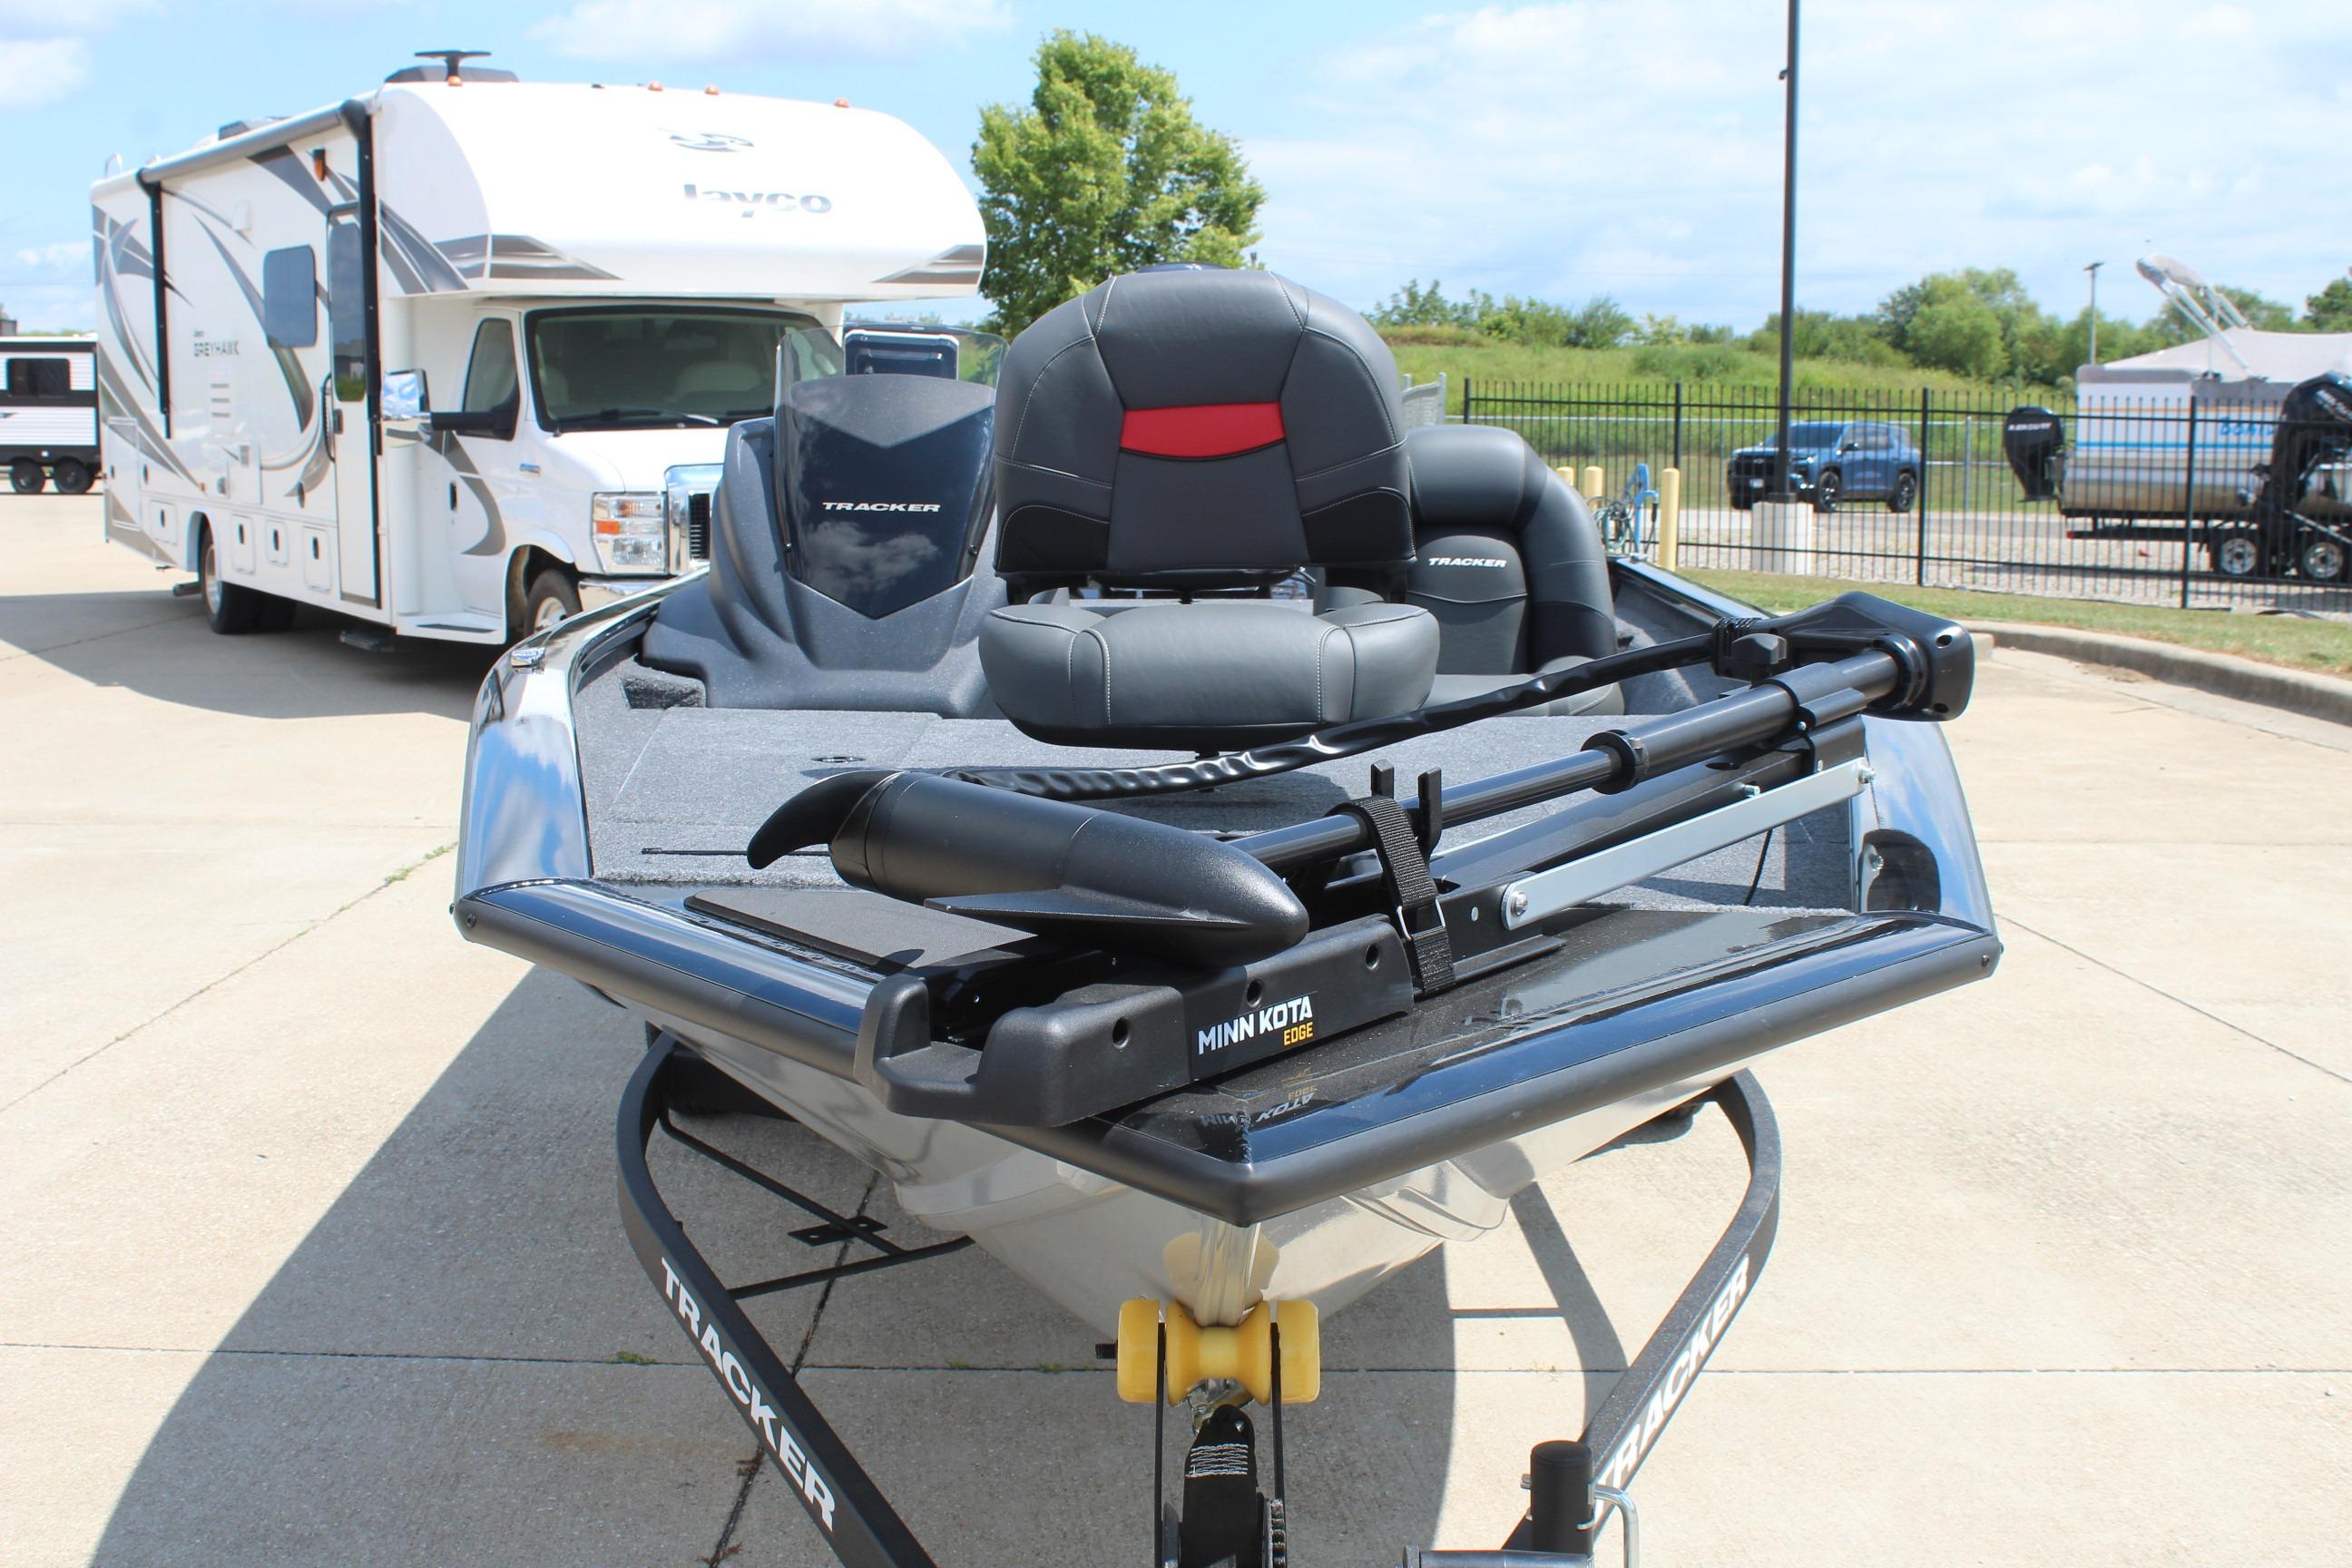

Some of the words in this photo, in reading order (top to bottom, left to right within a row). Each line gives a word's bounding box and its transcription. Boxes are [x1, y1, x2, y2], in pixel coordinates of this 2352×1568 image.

[822, 502, 941, 514] TRACKER
[1428, 557, 1507, 568] TRACKER
[1198, 1013, 1255, 1055] MINN
[1259, 995, 1314, 1034] KOTA
[1283, 1021, 1314, 1046] EDGE
[662, 1256, 835, 1532] TRACKER
